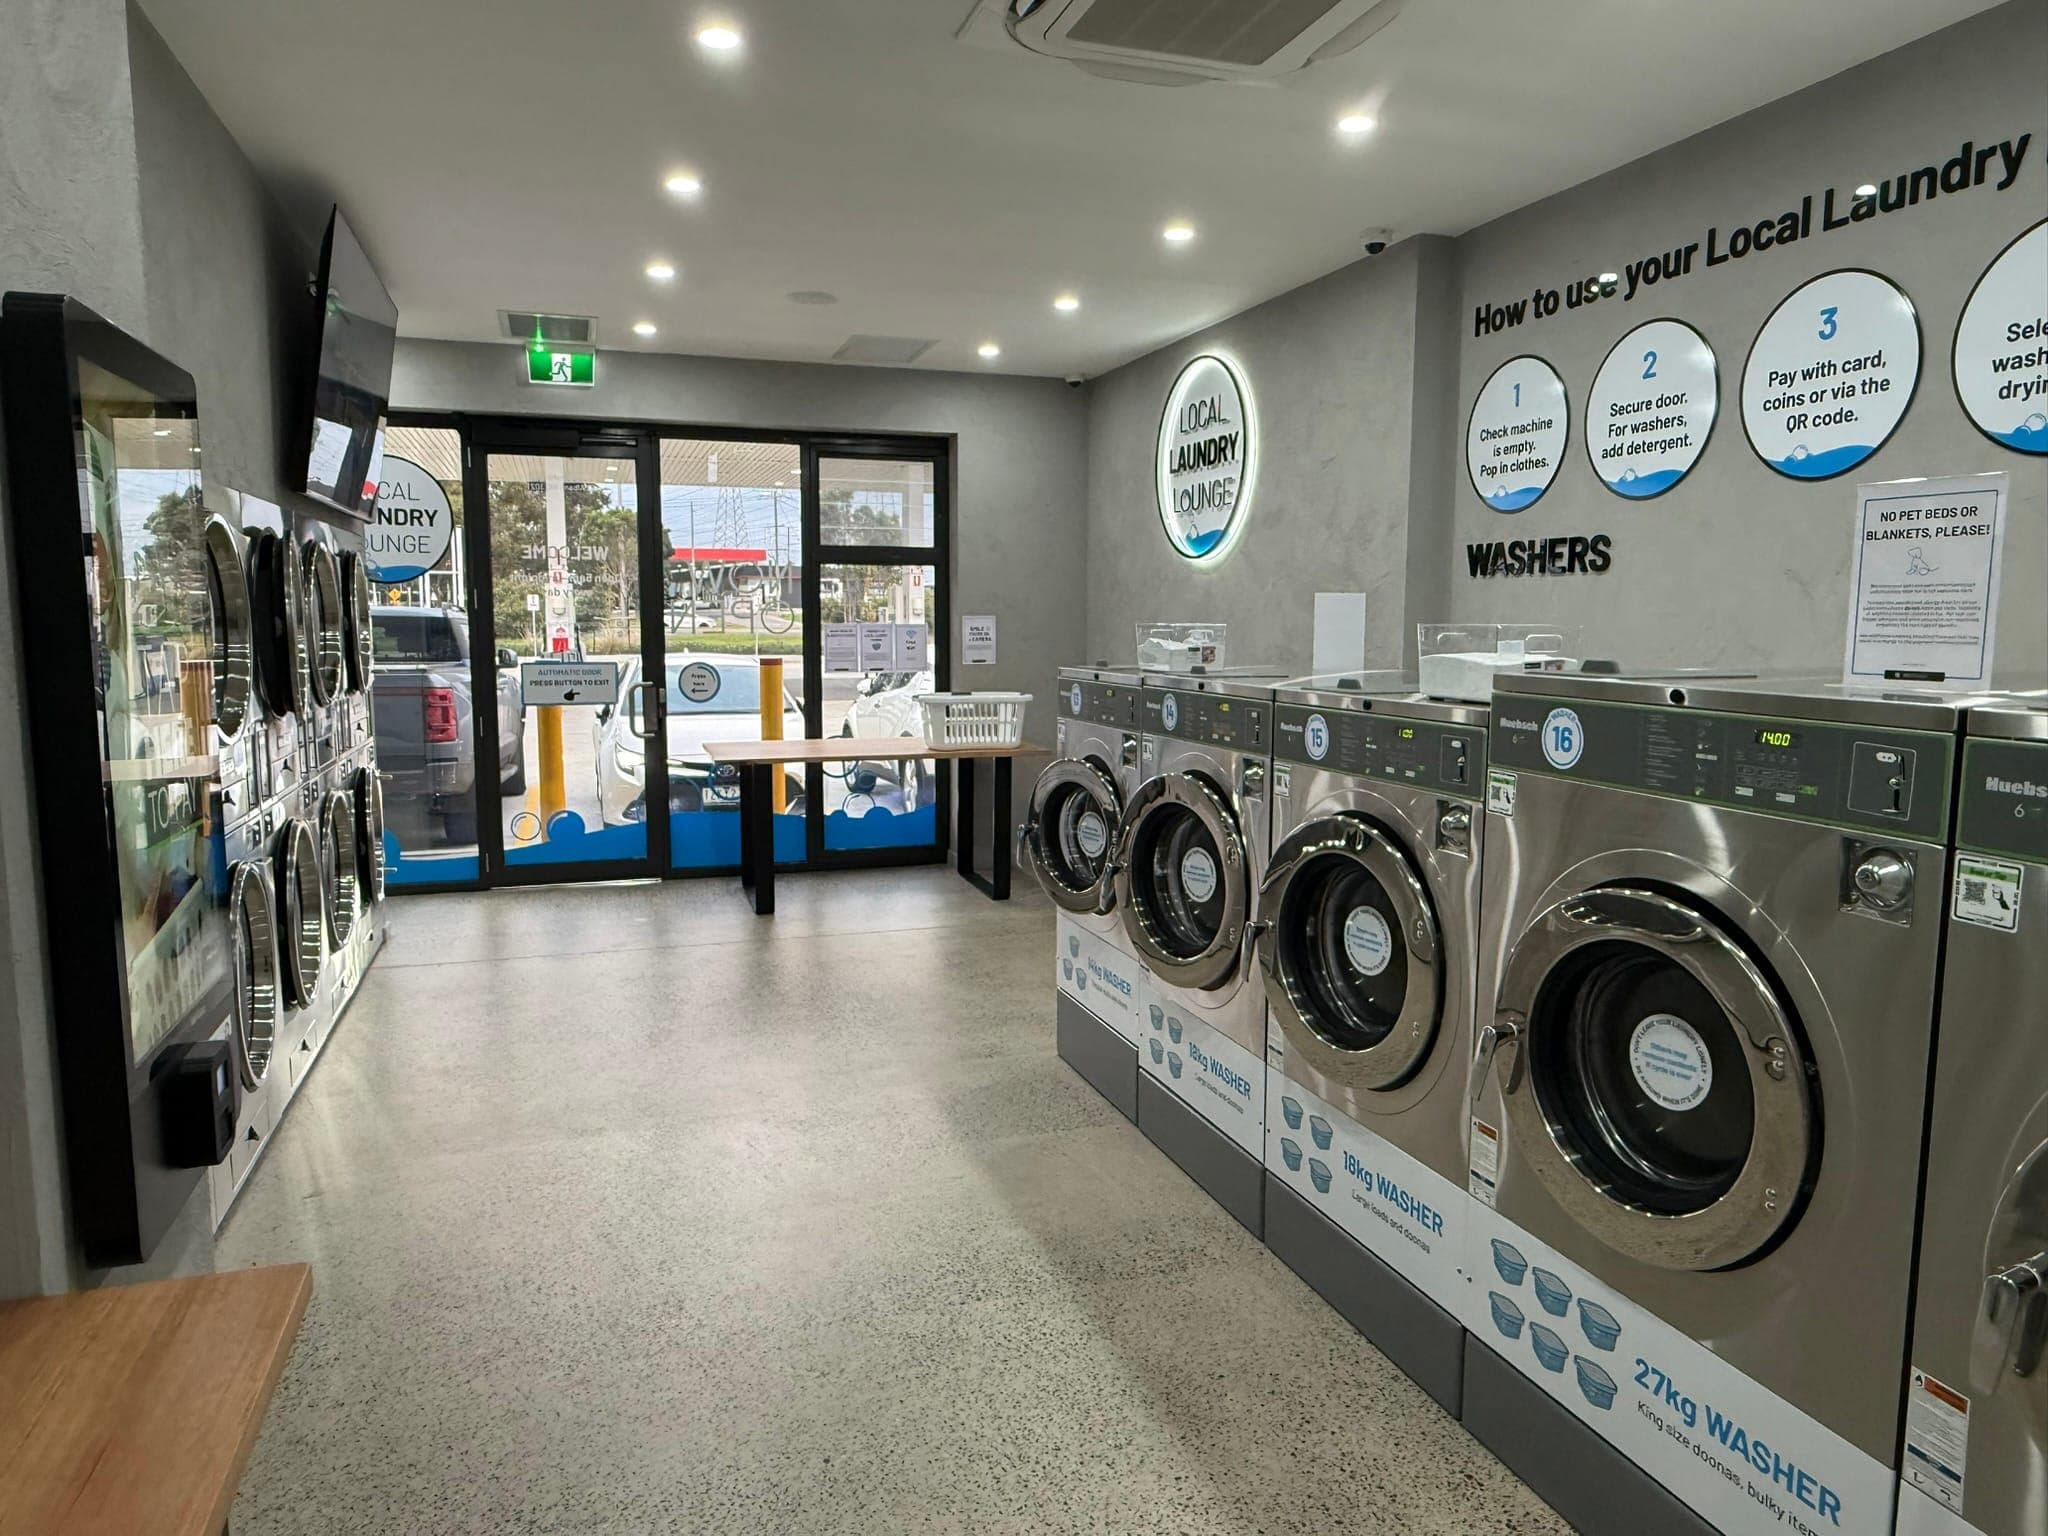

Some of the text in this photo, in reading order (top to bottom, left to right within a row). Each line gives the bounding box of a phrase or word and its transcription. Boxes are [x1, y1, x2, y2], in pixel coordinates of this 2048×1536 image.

[1474, 133, 2031, 337] How to use your Local Laundry
[1818, 306, 1838, 341] 3
[2006, 318, 2048, 342] Sele
[1642, 350, 1658, 380] 2
[1768, 350, 1886, 388] Pay with card,
[1992, 346, 2048, 373] wash
[1513, 383, 1521, 407] 1
[1609, 391, 1688, 417] Secure door.
[1763, 377, 1890, 412] coins or via the
[1180, 393, 1228, 434] LOCAL
[1608, 414, 1687, 438] For washers,
[1786, 407, 1858, 434] QR code.
[1480, 417, 1553, 442] Check machine
[1169, 431, 1239, 475] LAUNDRY
[1493, 440, 1536, 458] is empty.
[1601, 433, 1693, 459] add detergent.
[1480, 456, 1549, 478] Pop in clothes.
[378, 481, 421, 500] CAL
[1173, 477, 1235, 514] LOUNGE
[377, 507, 438, 527] NDRY
[1880, 505, 1978, 522] NO PET BEDS OR
[366, 534, 431, 553] UNGE
[1866, 524, 1990, 541] BLANKETS, PLEASE!
[1466, 534, 1613, 577] WASHERS
[554, 679, 582, 687] BUTTON
[1166, 704, 1174, 721] 14
[1311, 728, 1323, 748] 15
[1552, 726, 1573, 753] 16
[1761, 731, 1791, 746] 14.00
[1189, 1041, 1208, 1072] 18kg
[1210, 1056, 1251, 1101] WASHER
[1343, 1150, 1443, 1237] 18kg WASHER
[1634, 1358, 1697, 1428] 27kg
[1705, 1404, 1841, 1527] WASHER
[1638, 1400, 1663, 1431] King
[1665, 1422, 1690, 1449] size
[1747, 1481, 1785, 1521] bulky
